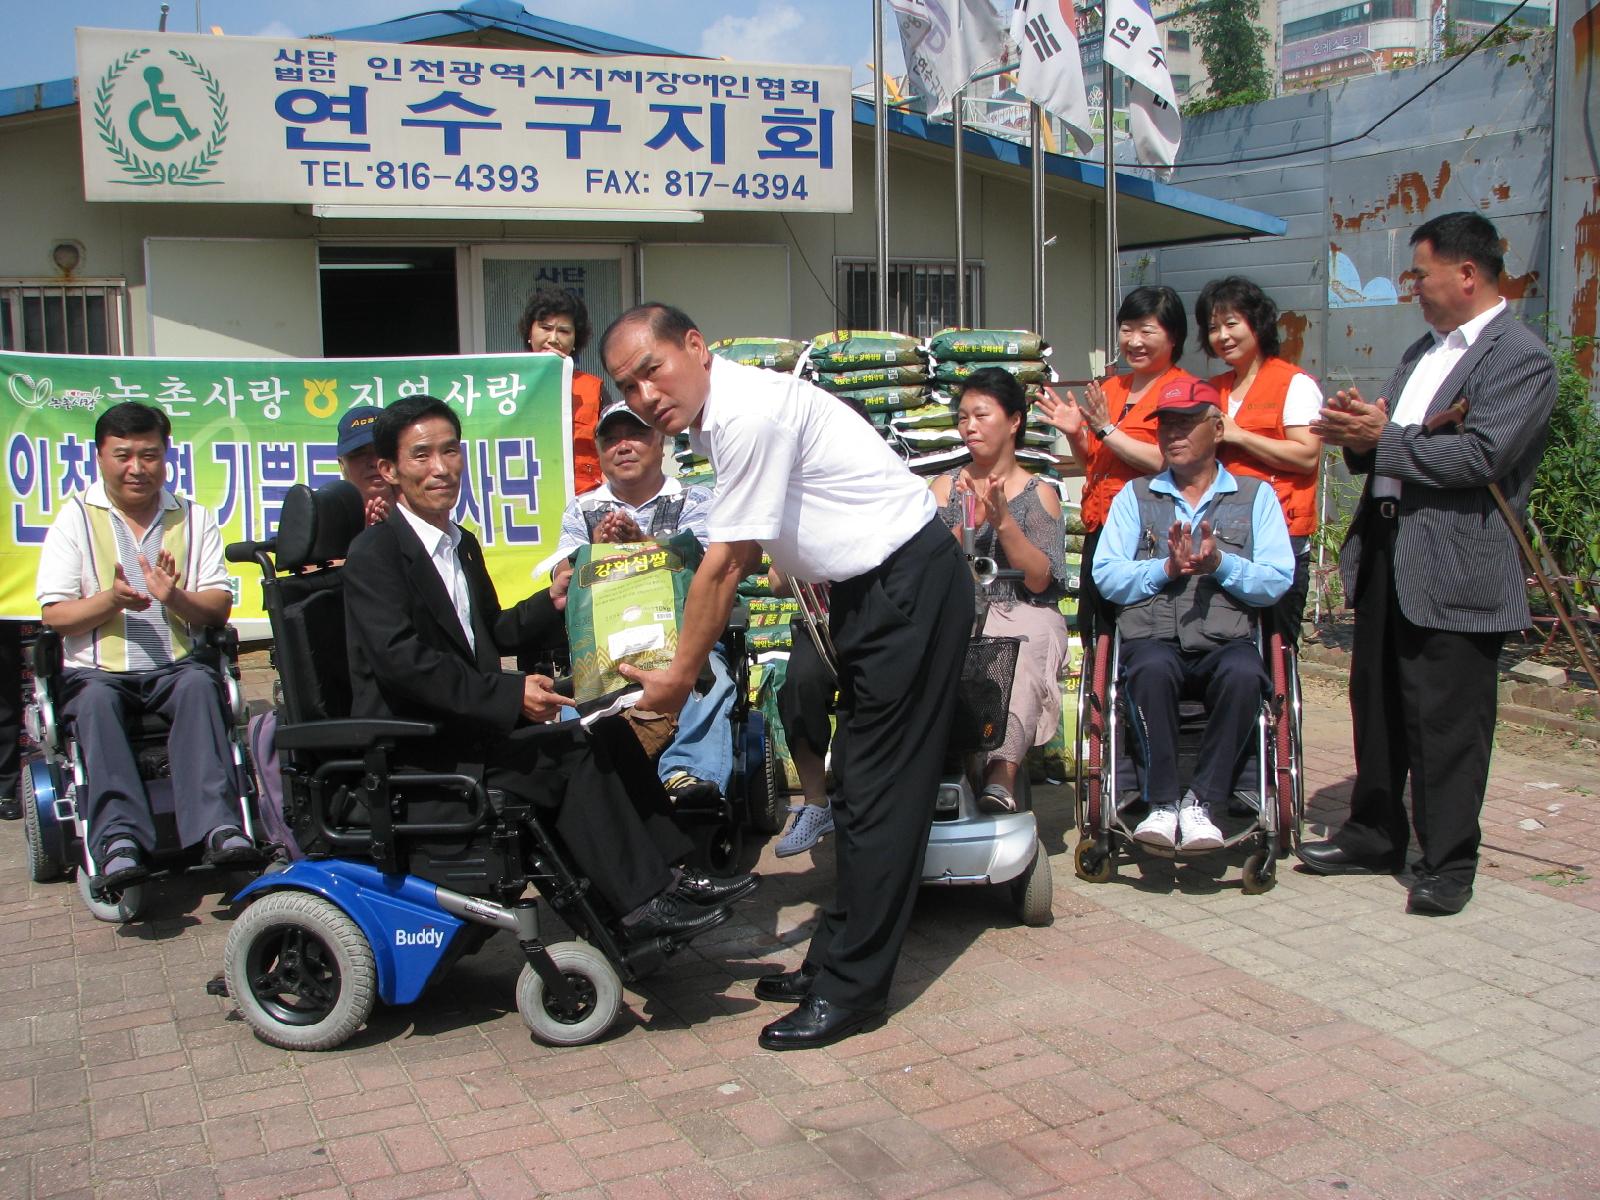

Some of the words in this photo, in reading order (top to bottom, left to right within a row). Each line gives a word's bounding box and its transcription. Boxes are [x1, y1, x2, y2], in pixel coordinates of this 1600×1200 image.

[273, 48, 337, 66] 사단
[275, 67, 337, 82] 법인
[274, 84, 835, 169] 연수구지회
[664, 169, 809, 200] 817-4394
[594, 551, 668, 577] 강화섬쌀
[395, 927, 445, 948] Buddy
